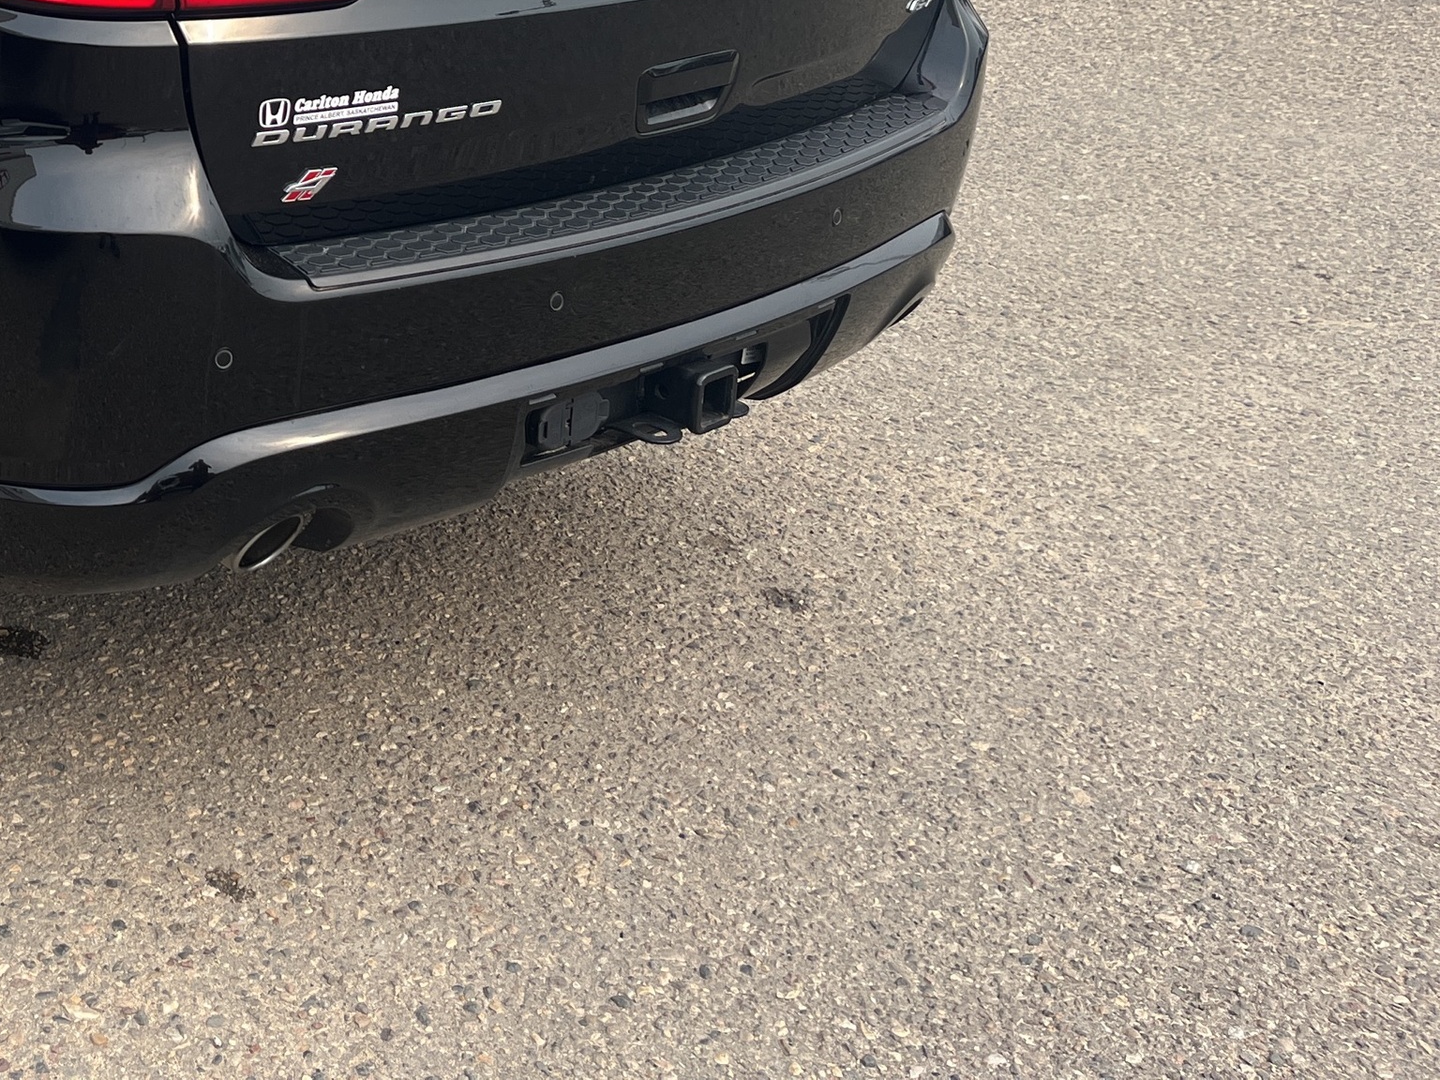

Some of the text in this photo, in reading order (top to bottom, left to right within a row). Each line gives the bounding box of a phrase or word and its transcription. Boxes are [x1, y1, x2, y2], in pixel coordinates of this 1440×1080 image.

[294, 85, 400, 113] Carlton Honda
[251, 99, 503, 148] DURANGO
[295, 114, 319, 122] PRINCE
